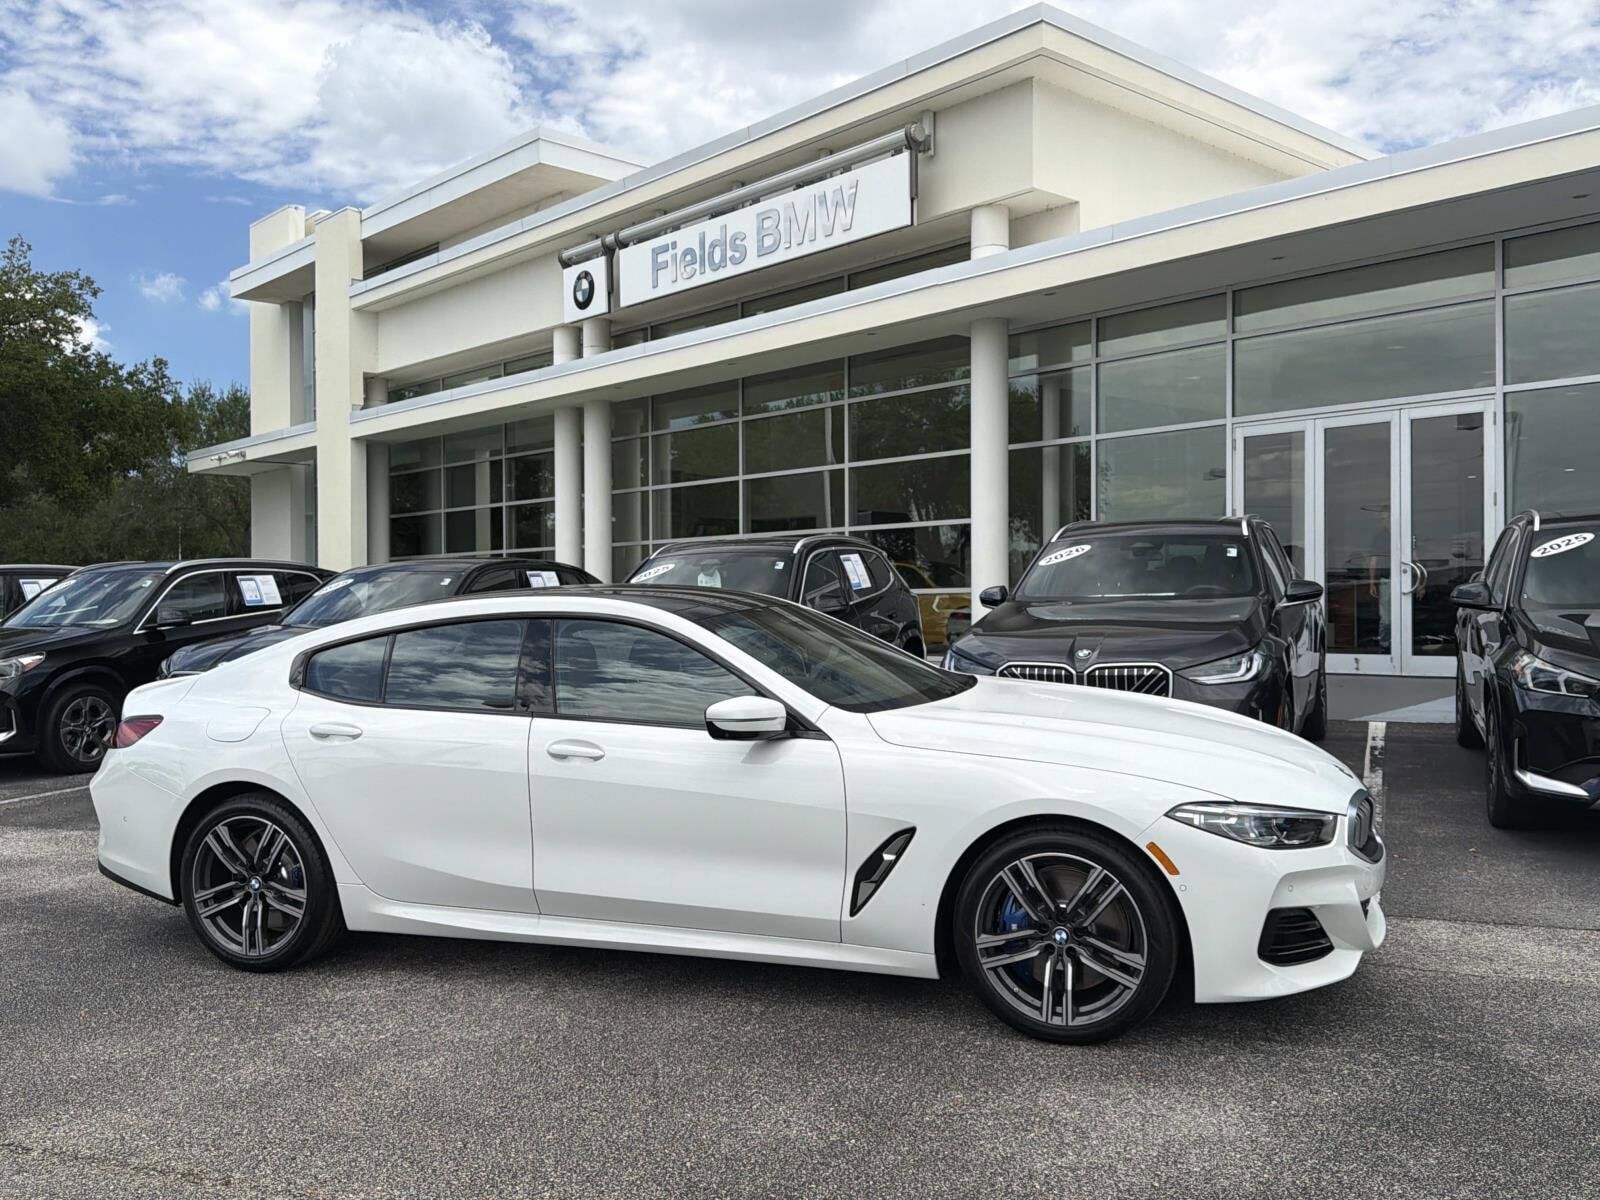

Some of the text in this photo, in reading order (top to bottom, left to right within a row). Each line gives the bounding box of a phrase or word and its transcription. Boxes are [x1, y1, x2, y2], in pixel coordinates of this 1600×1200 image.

[651, 179, 860, 290] Fields BMW
[1536, 534, 1588, 556] 2025
